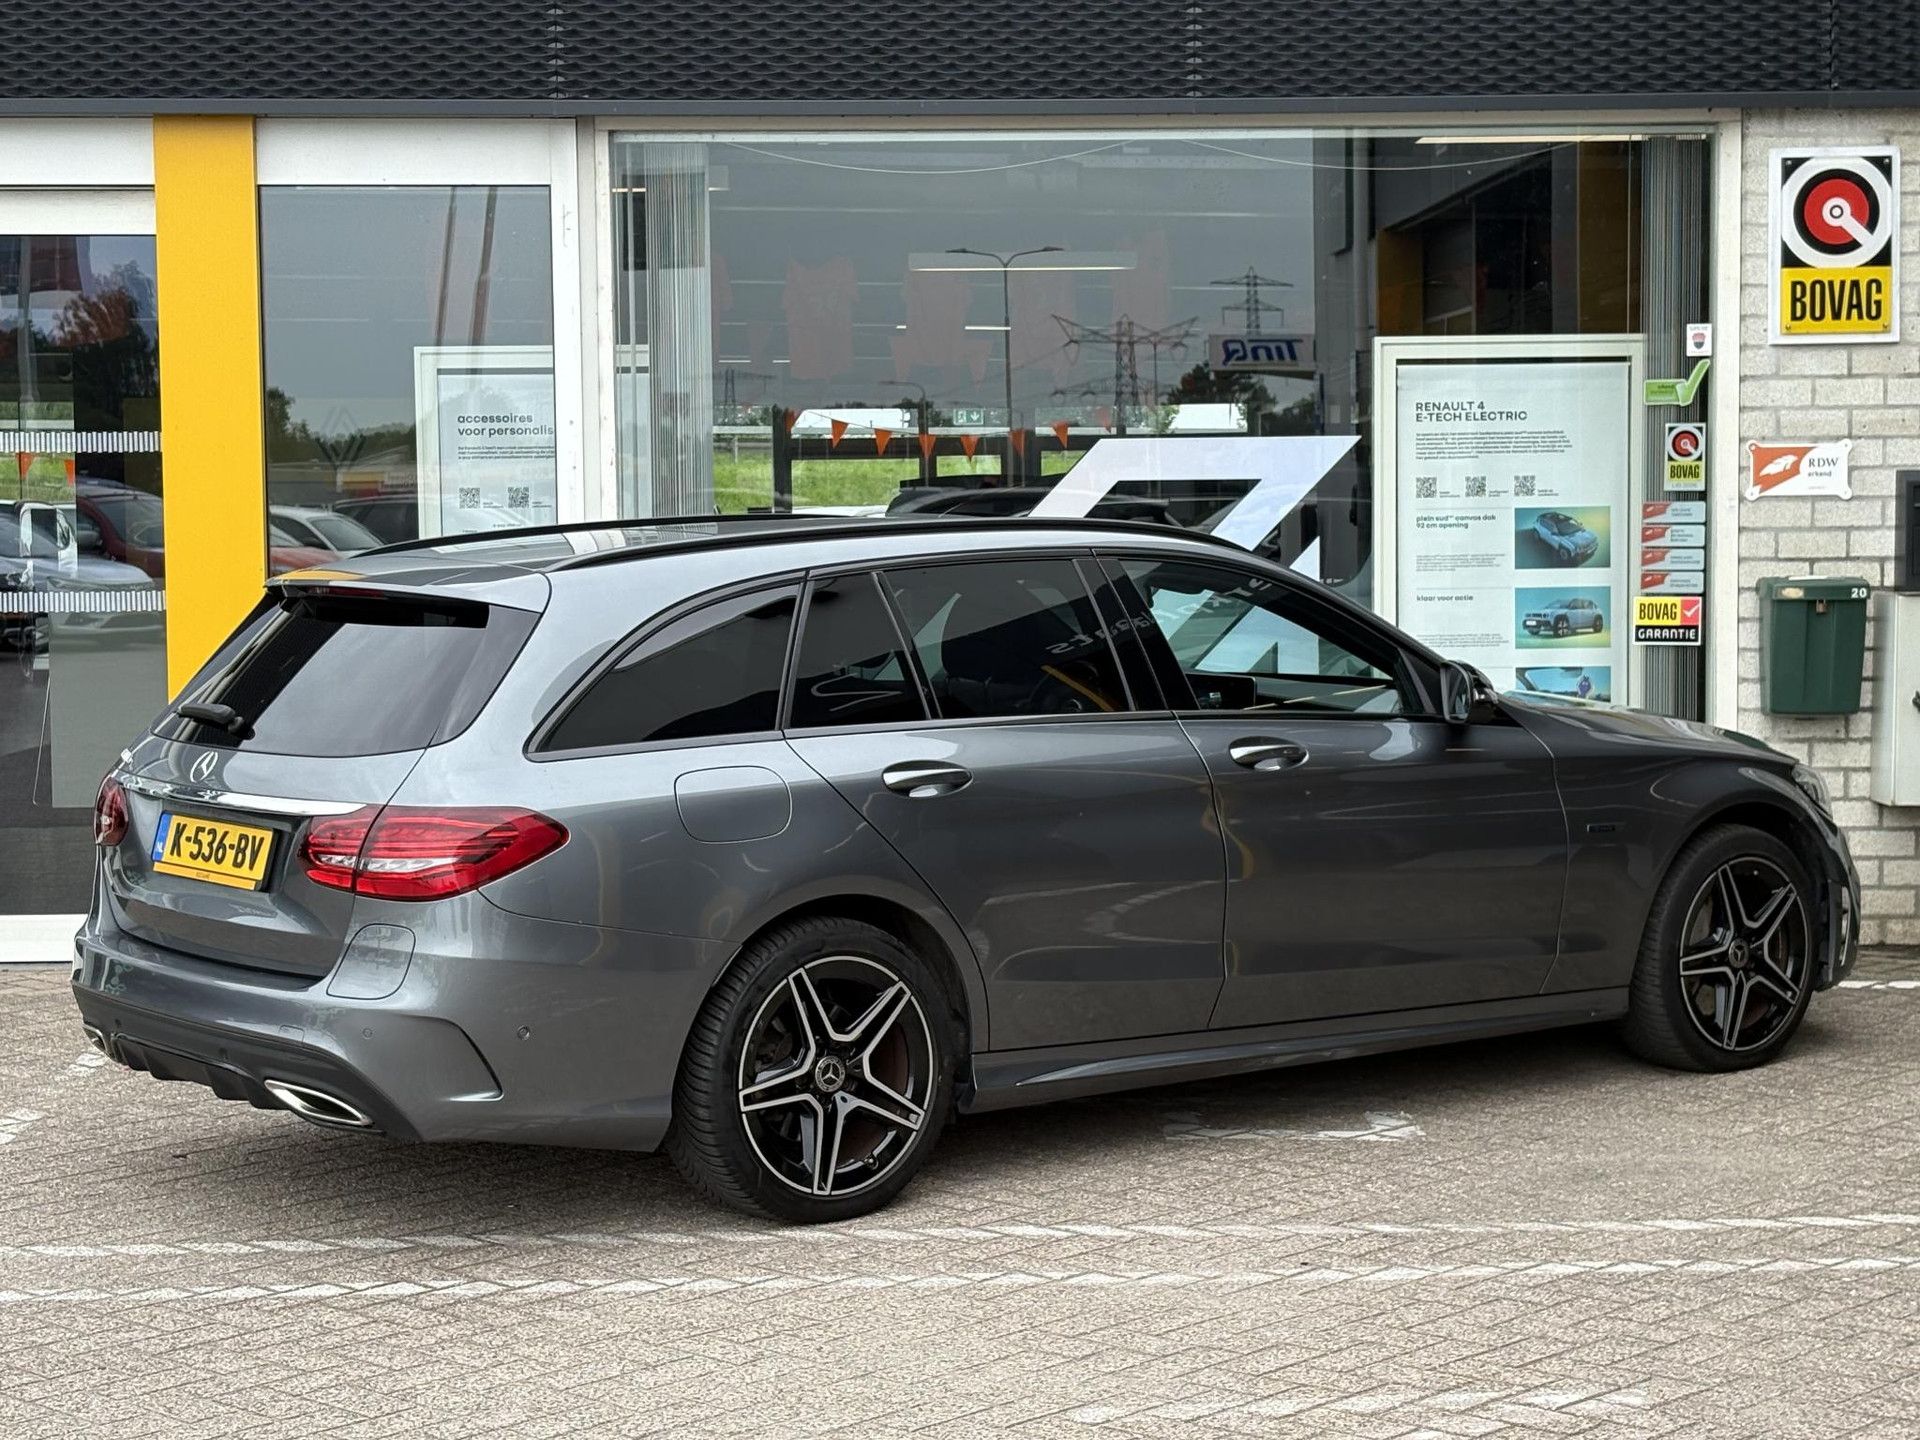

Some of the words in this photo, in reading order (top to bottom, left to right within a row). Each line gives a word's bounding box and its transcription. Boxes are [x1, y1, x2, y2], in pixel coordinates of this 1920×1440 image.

[1790, 278, 1883, 322] BOVAG
[1415, 401, 1475, 412] RENAULT
[1477, 401, 1486, 411] 4
[457, 413, 533, 423] accessoires
[1415, 412, 1462, 422] E-TECH
[1465, 411, 1528, 421] ELECTRIC
[457, 427, 486, 436] voor
[488, 425, 554, 438] personalis
[1808, 457, 1839, 468] RDW
[1669, 464, 1700, 479] BOVAG
[1416, 515, 1434, 523] plein
[1438, 522, 1469, 530] opening
[1851, 587, 1867, 599] 20
[1639, 602, 1677, 620] BOVAG
[1637, 628, 1696, 639] GARANTIE
[169, 822, 265, 871] K-536-BV
